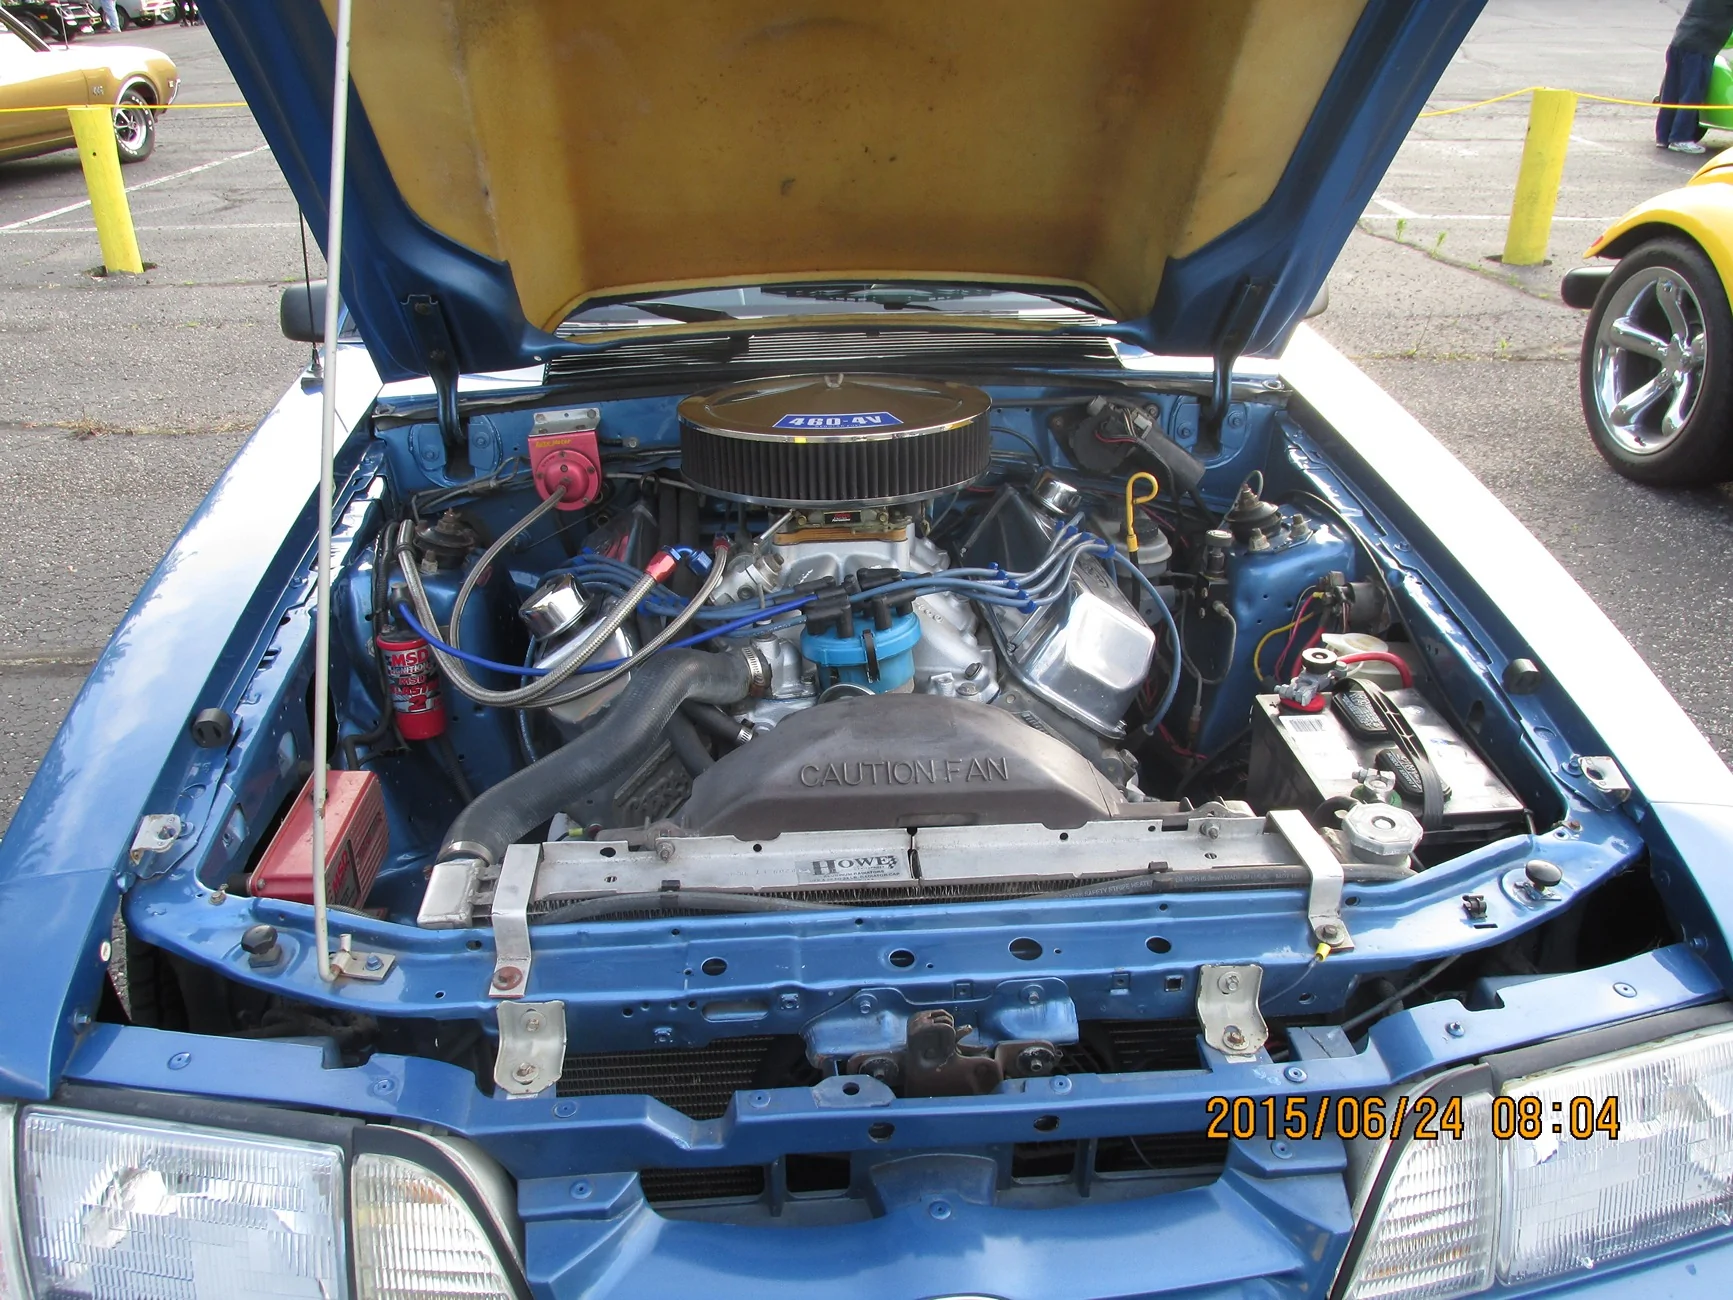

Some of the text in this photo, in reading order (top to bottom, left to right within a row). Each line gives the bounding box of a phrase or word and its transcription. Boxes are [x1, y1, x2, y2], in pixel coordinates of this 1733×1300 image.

[788, 415, 882, 426] 460-4V
[391, 649, 428, 667] MSD
[408, 694, 428, 711] 2
[800, 757, 1010, 788] CAUTION FAN
[812, 856, 892, 875] HOWE
